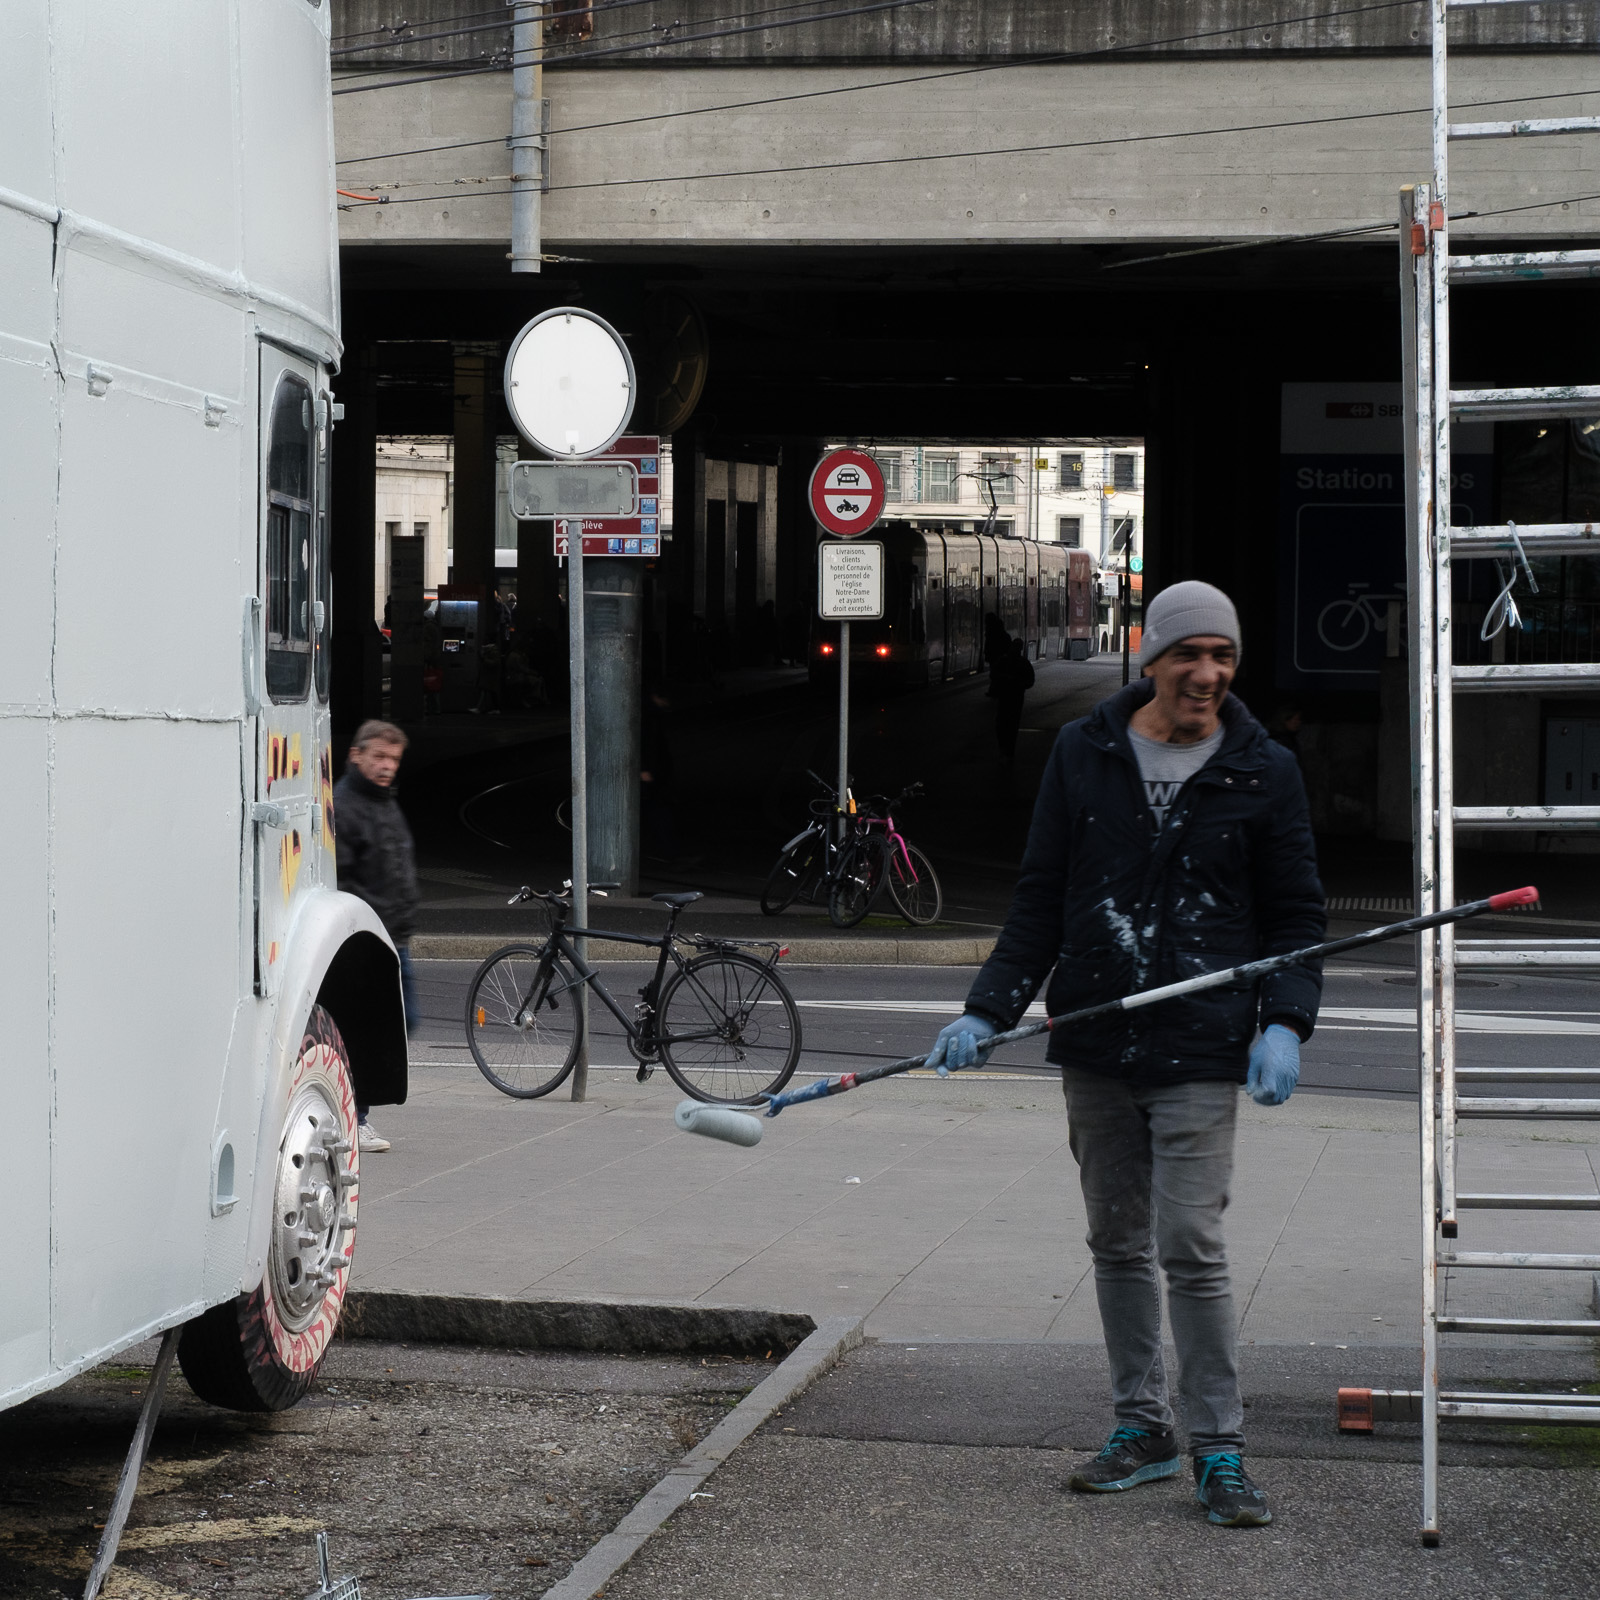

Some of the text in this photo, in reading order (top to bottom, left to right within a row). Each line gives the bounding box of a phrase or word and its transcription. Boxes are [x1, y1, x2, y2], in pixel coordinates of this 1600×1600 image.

[1071, 462, 1083, 472] 15
[1296, 467, 1393, 490] Station
[581, 520, 603, 530] alève
[625, 538, 638, 549] 46
[846, 564, 874, 572] Cornavin,
[833, 572, 862, 580] personnel
[841, 580, 862, 589] l'église
[835, 588, 870, 596] Notre-Dame
[846, 597, 865, 605] ayants
[848, 605, 873, 613] exceptés
